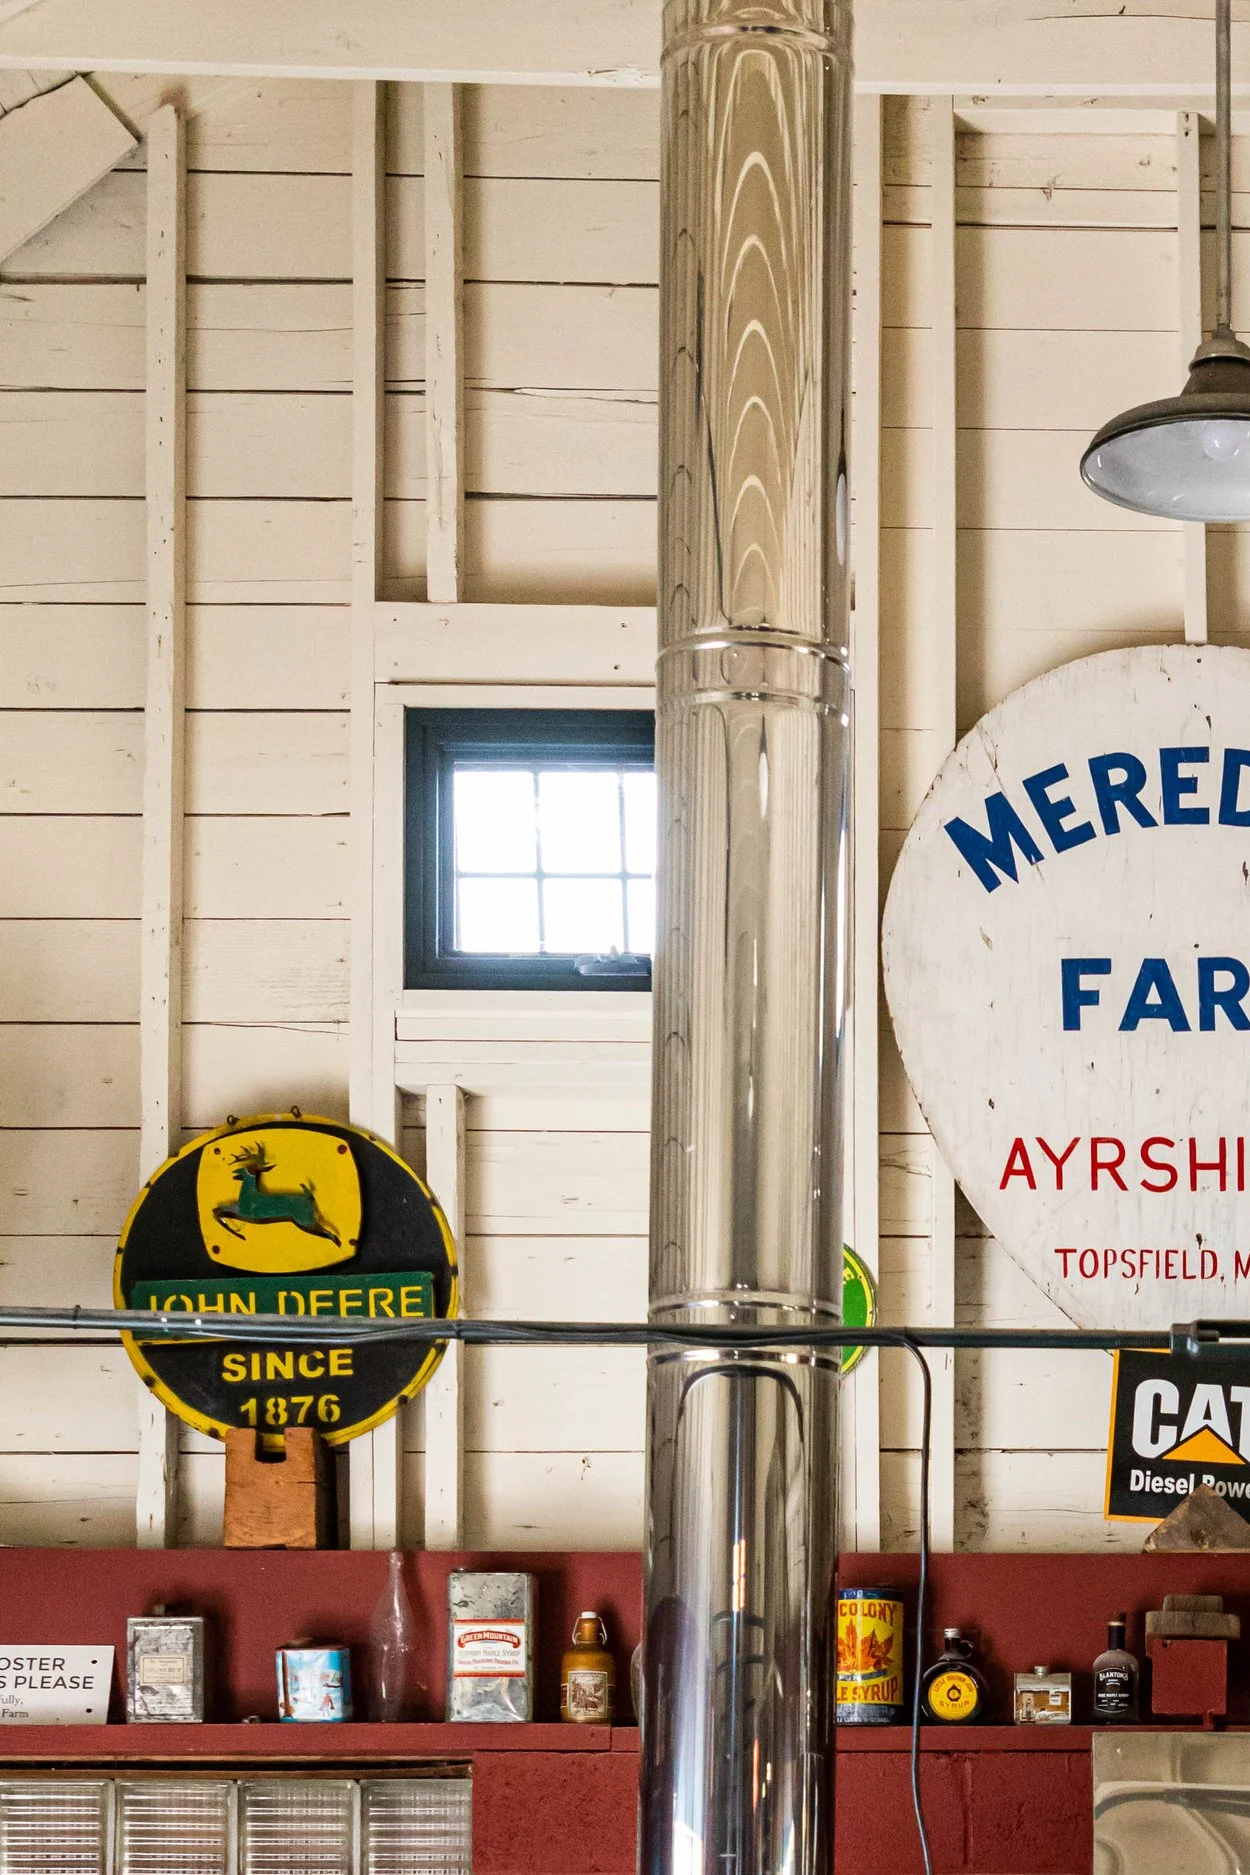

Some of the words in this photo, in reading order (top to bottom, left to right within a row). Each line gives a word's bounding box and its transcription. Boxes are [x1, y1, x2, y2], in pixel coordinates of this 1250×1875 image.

[1054, 1247, 1226, 1283] TOPSFIELD,
[278, 1286, 424, 1319] DEERE
[222, 1349, 354, 1383] SINCE
[239, 1394, 341, 1427] 1876
[1130, 1469, 1195, 1495] Diesel
[839, 1601, 897, 1627] COLONY
[460, 1633, 483, 1644] GREEN
[483, 1631, 518, 1644] MOUNTAIN
[14, 1675, 95, 1690] PLEASE
[853, 1675, 898, 1702] SYRUP
[2, 1708, 29, 1718] Farm
[939, 1700, 970, 1708] SYRUP
